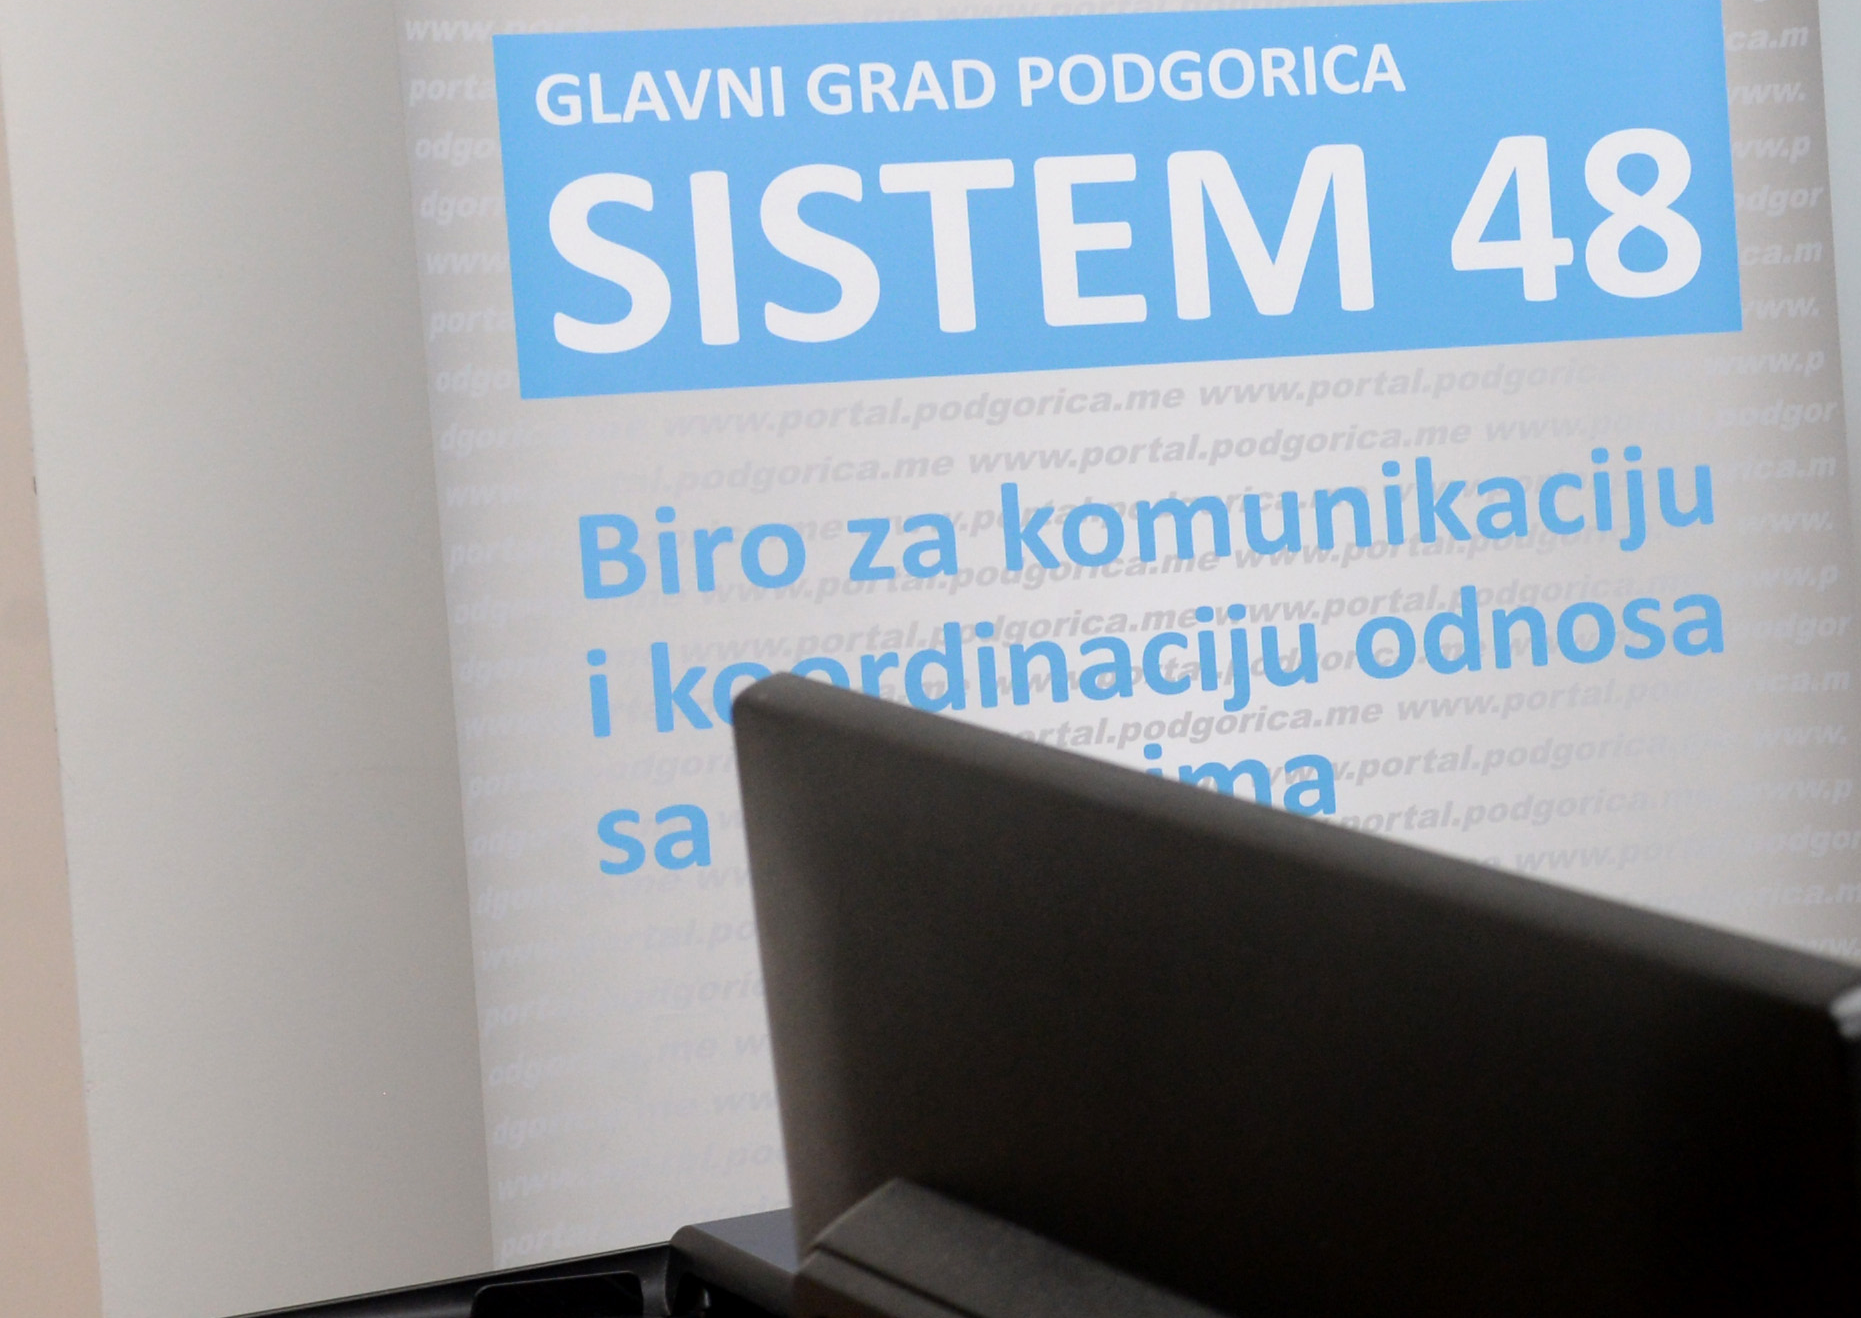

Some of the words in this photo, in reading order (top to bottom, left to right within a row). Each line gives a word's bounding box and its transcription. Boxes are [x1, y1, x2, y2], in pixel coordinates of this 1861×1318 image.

[536, 66, 785, 126] GLAVNI
[807, 59, 992, 115] GRAD
[1019, 43, 1406, 107] PODGORICA
[550, 144, 1374, 354] SISTEM
[1451, 128, 1702, 301] 48
[968, 420, 1472, 474] www.portal.podgorica.me
[578, 505, 807, 600] Biro
[847, 513, 959, 582] za
[1001, 445, 1715, 572] komunikaciju
[586, 648, 612, 738] i
[1355, 584, 1725, 680] odnosa
[597, 804, 712, 876] sa
